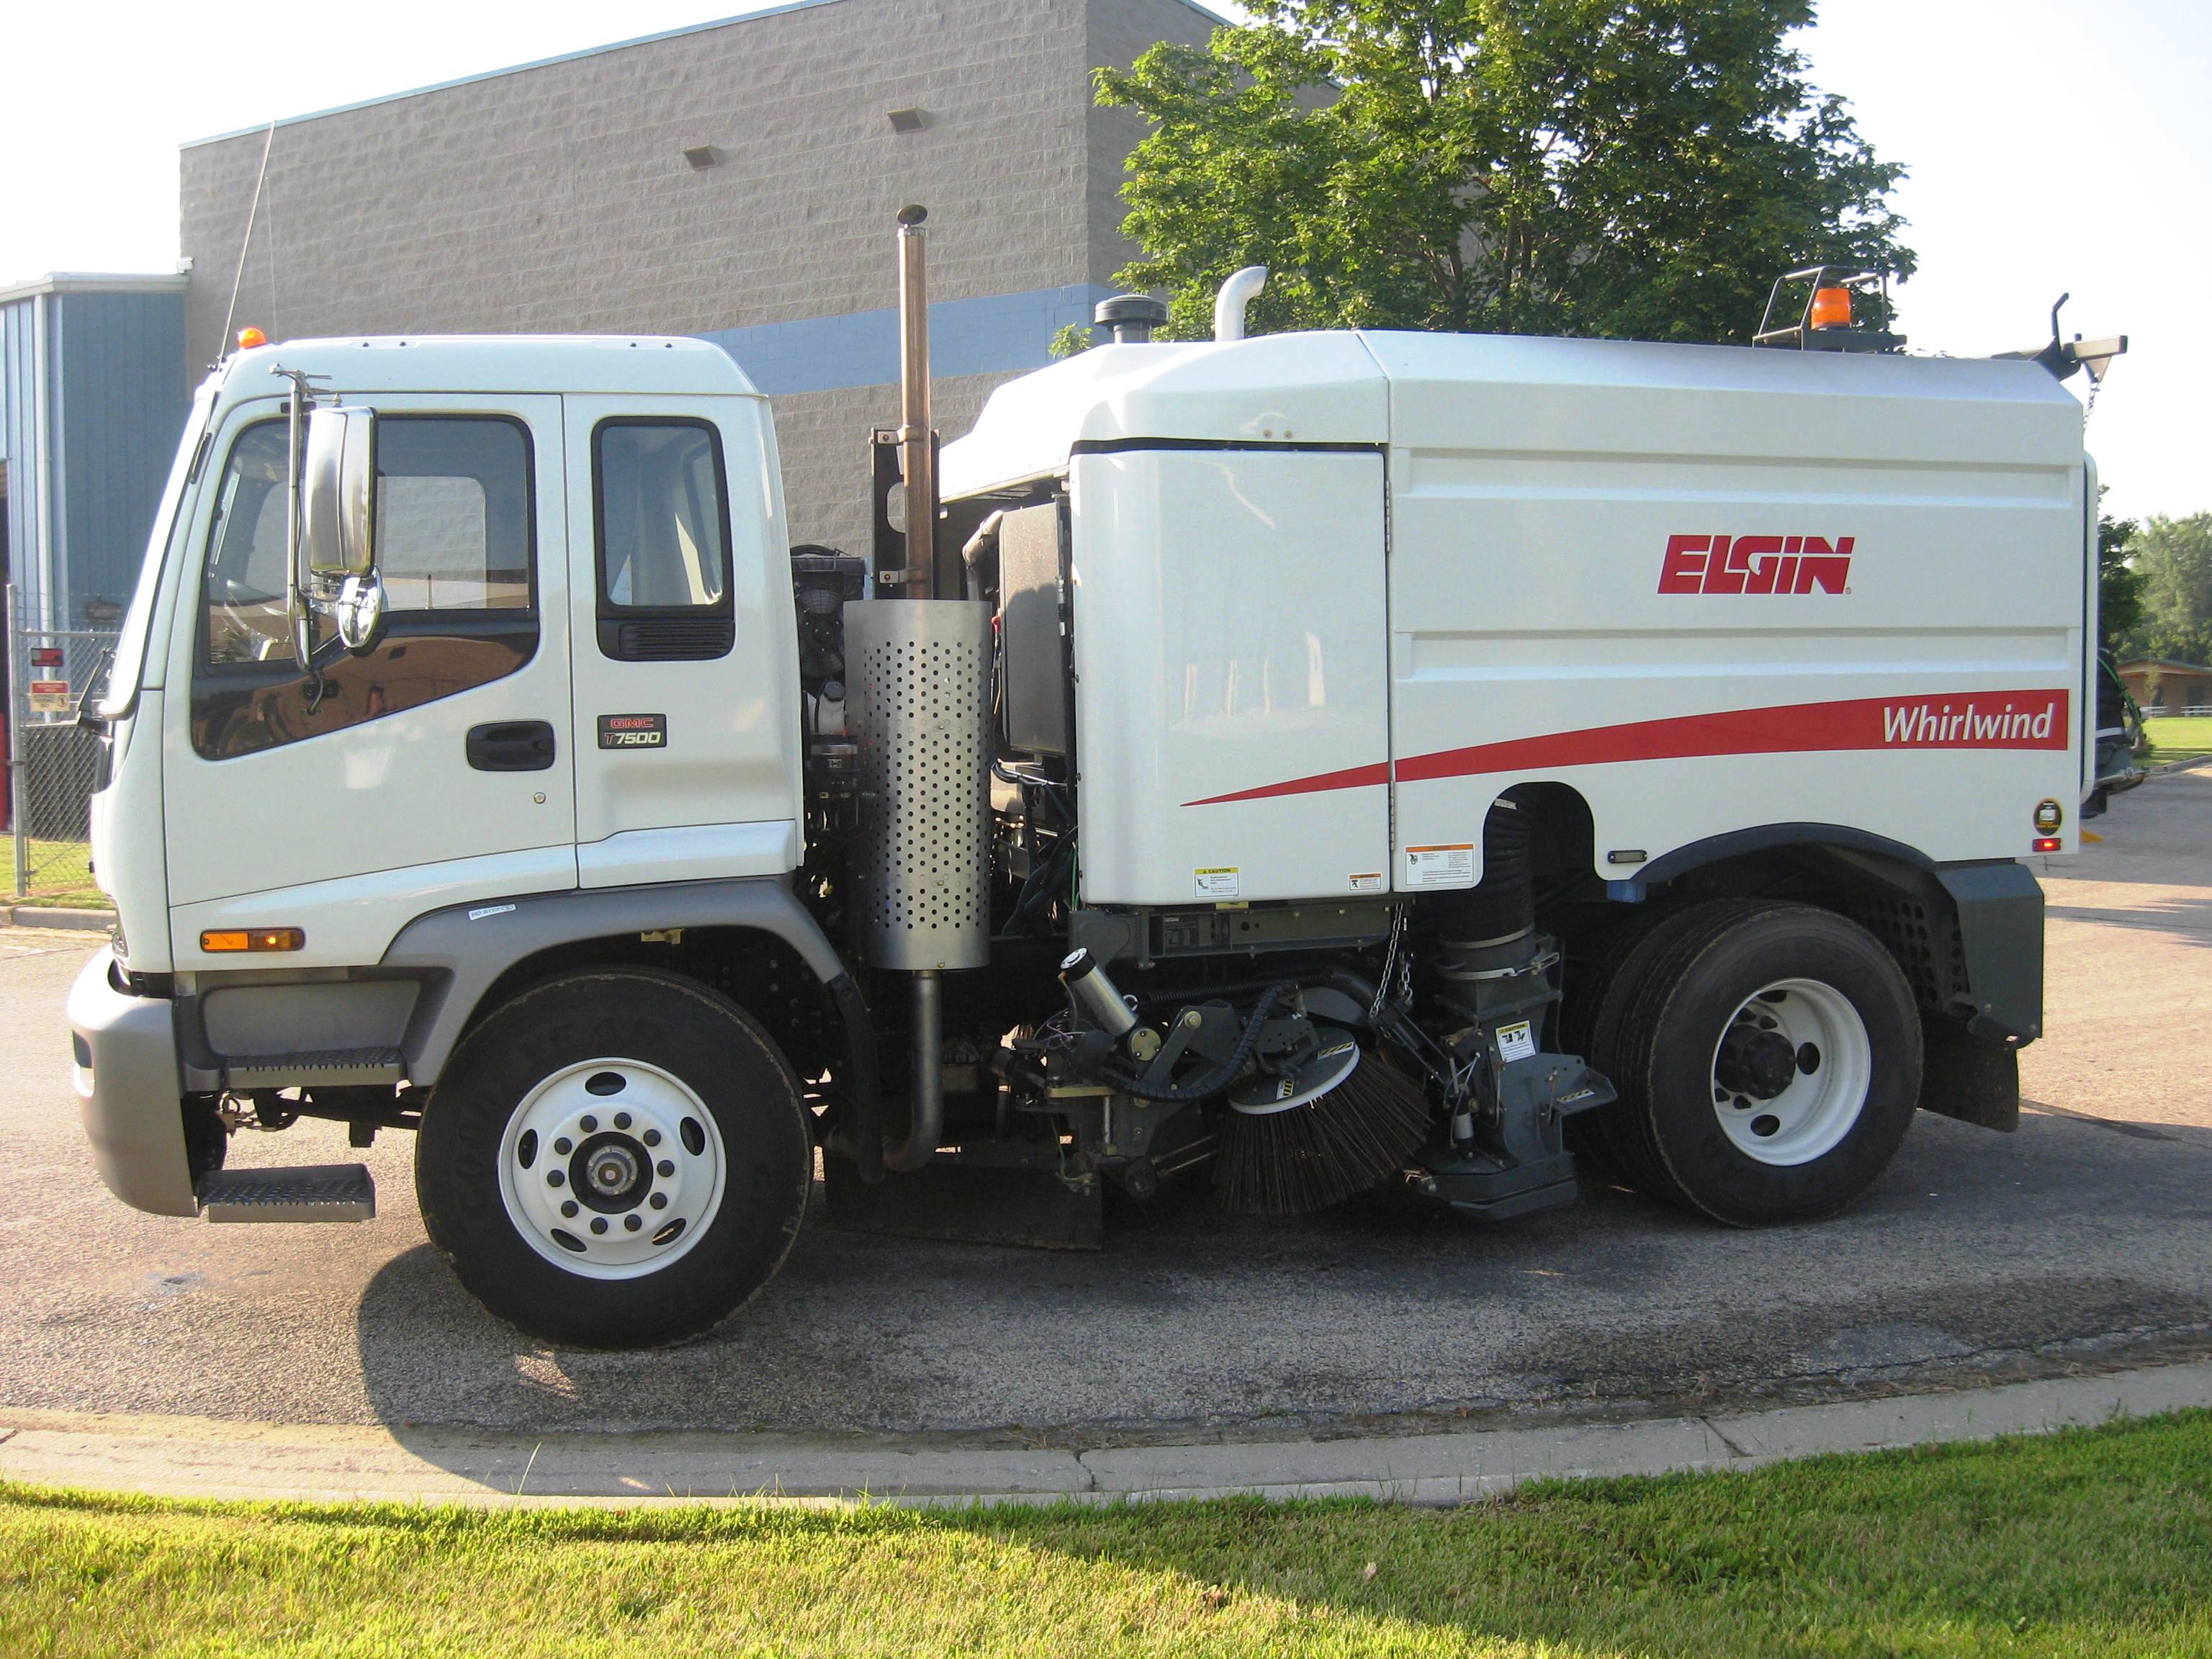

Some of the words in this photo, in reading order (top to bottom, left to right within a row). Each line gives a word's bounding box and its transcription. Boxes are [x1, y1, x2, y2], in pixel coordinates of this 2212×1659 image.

[1657, 534, 1856, 594] ELGIN
[610, 718, 654, 729] GMC
[1884, 703, 2054, 743] Whirlwind
[604, 732, 662, 745] T7500
